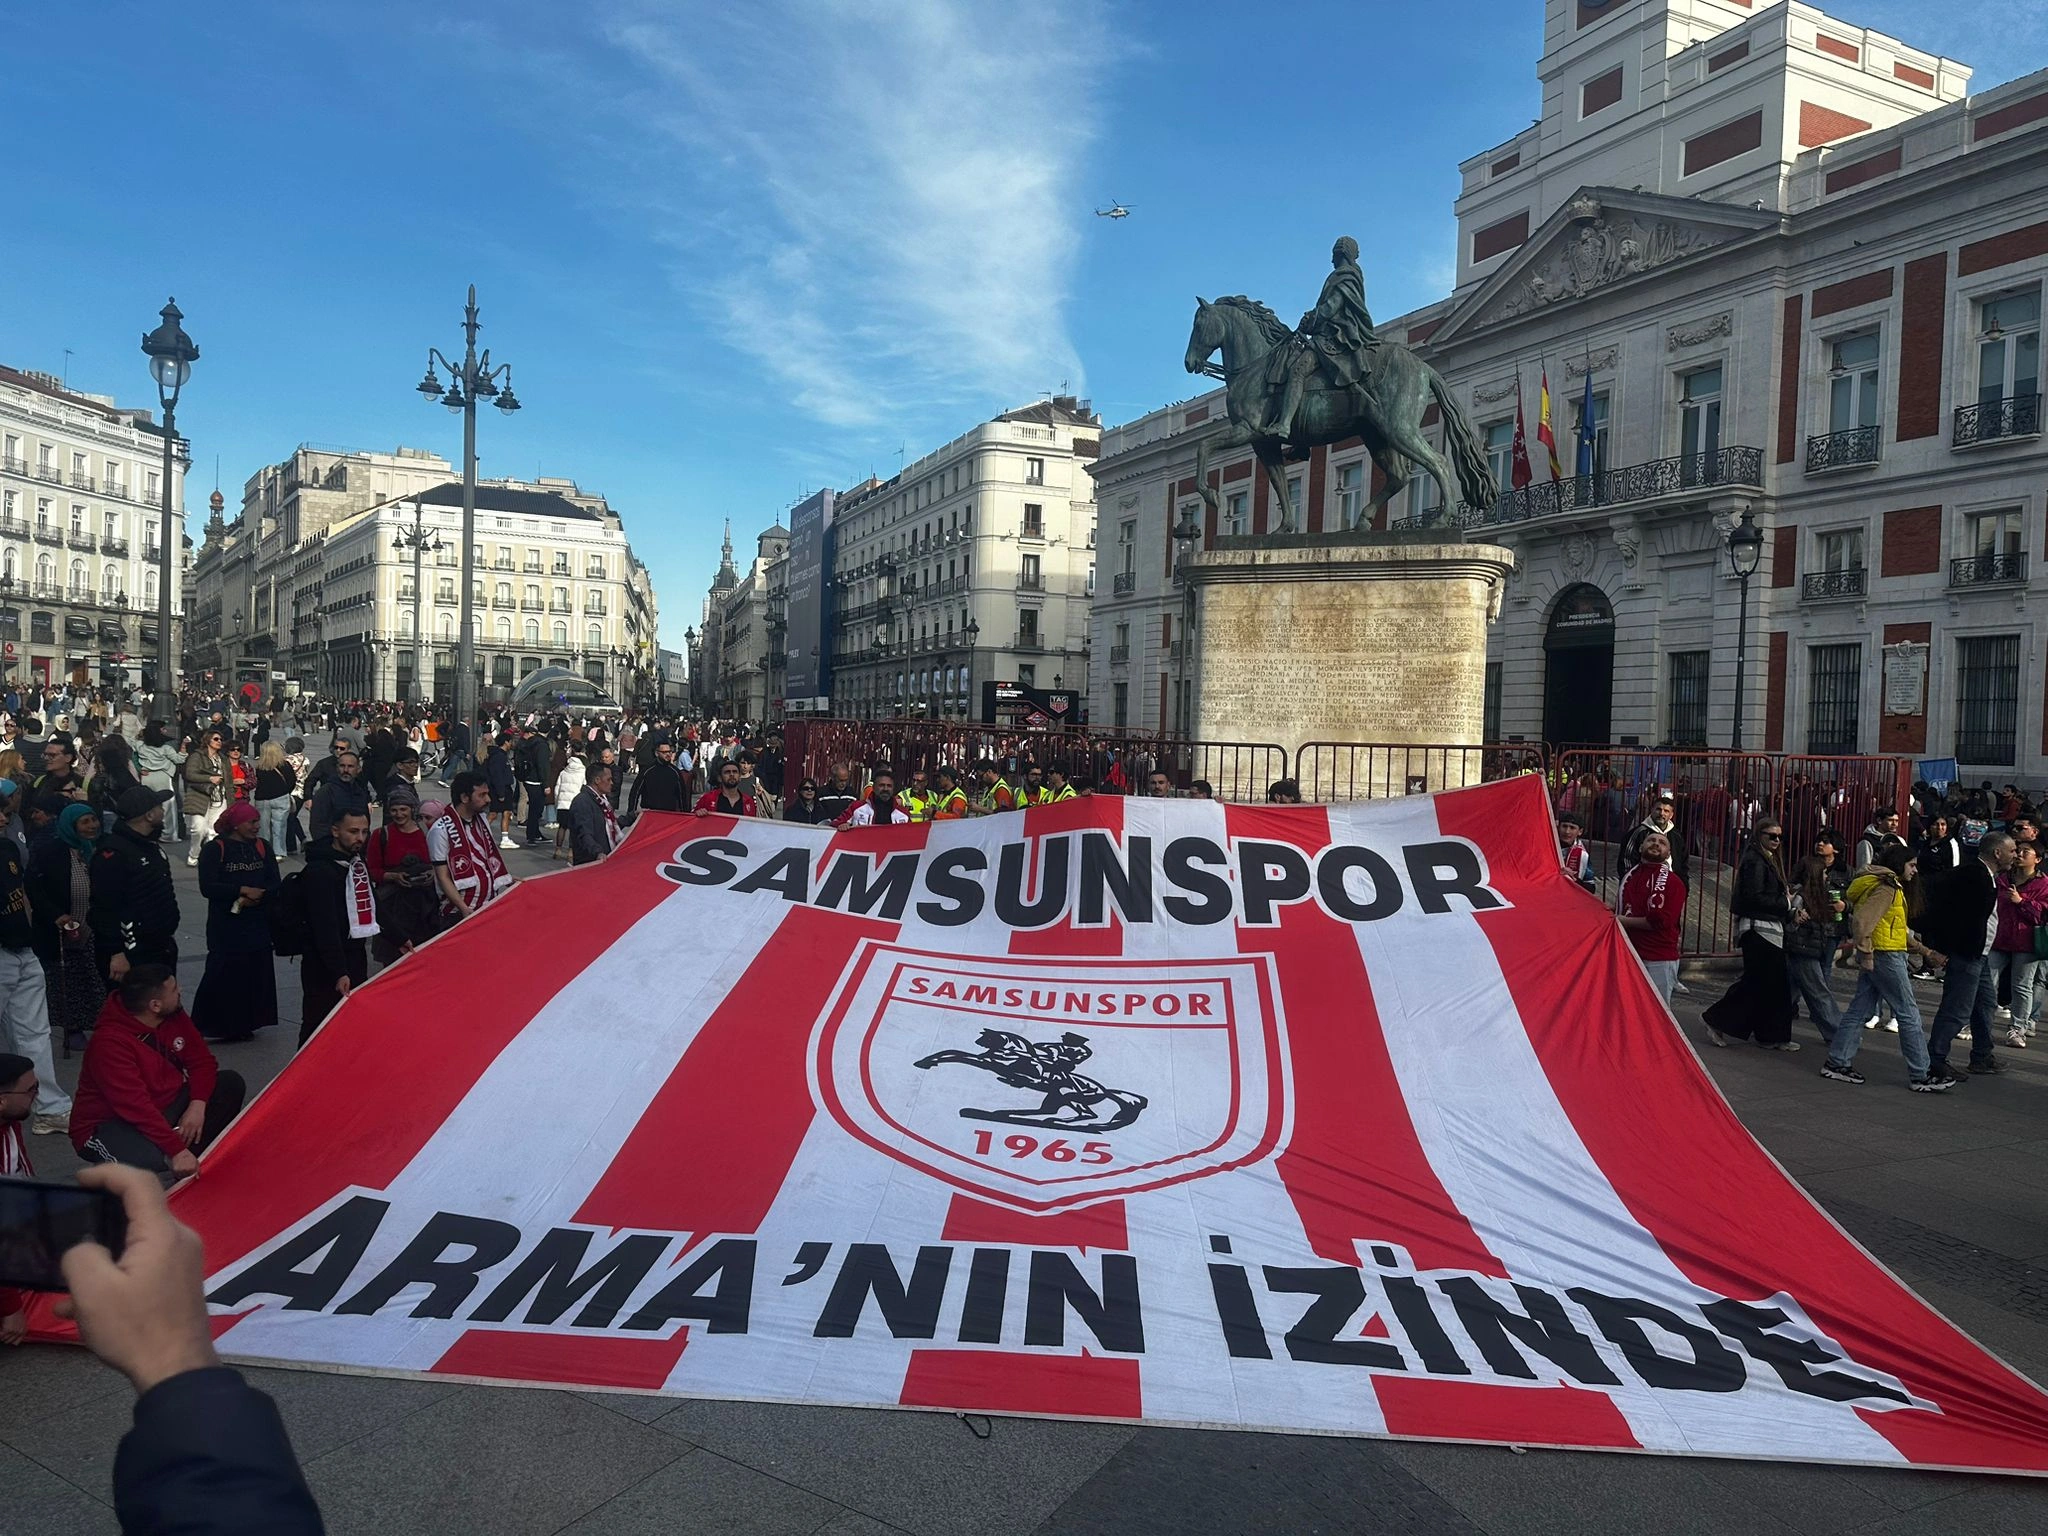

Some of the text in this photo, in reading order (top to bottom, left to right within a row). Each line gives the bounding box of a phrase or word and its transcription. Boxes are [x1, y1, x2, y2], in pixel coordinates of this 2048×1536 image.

[1556, 620, 1585, 628] COMUNIDAD
[1360, 659, 1393, 667] CASADO
[1318, 665, 1353, 673] MONARCA
[1279, 697, 1329, 705] PROVENIENTES
[1319, 717, 1384, 725] ESTABLECIMIENTO
[1401, 719, 1465, 728] ALCANTARILLADO
[1313, 723, 1355, 731] APLICACION
[1372, 725, 1418, 733] ORDENANZAS
[1421, 726, 1465, 734] MVNICIPALES
[442, 815, 463, 849] KING
[664, 836, 1505, 926] SAMSUNSPOR
[909, 977, 1213, 1016] SAMSUNSPOR
[974, 1129, 1114, 1165] 1965
